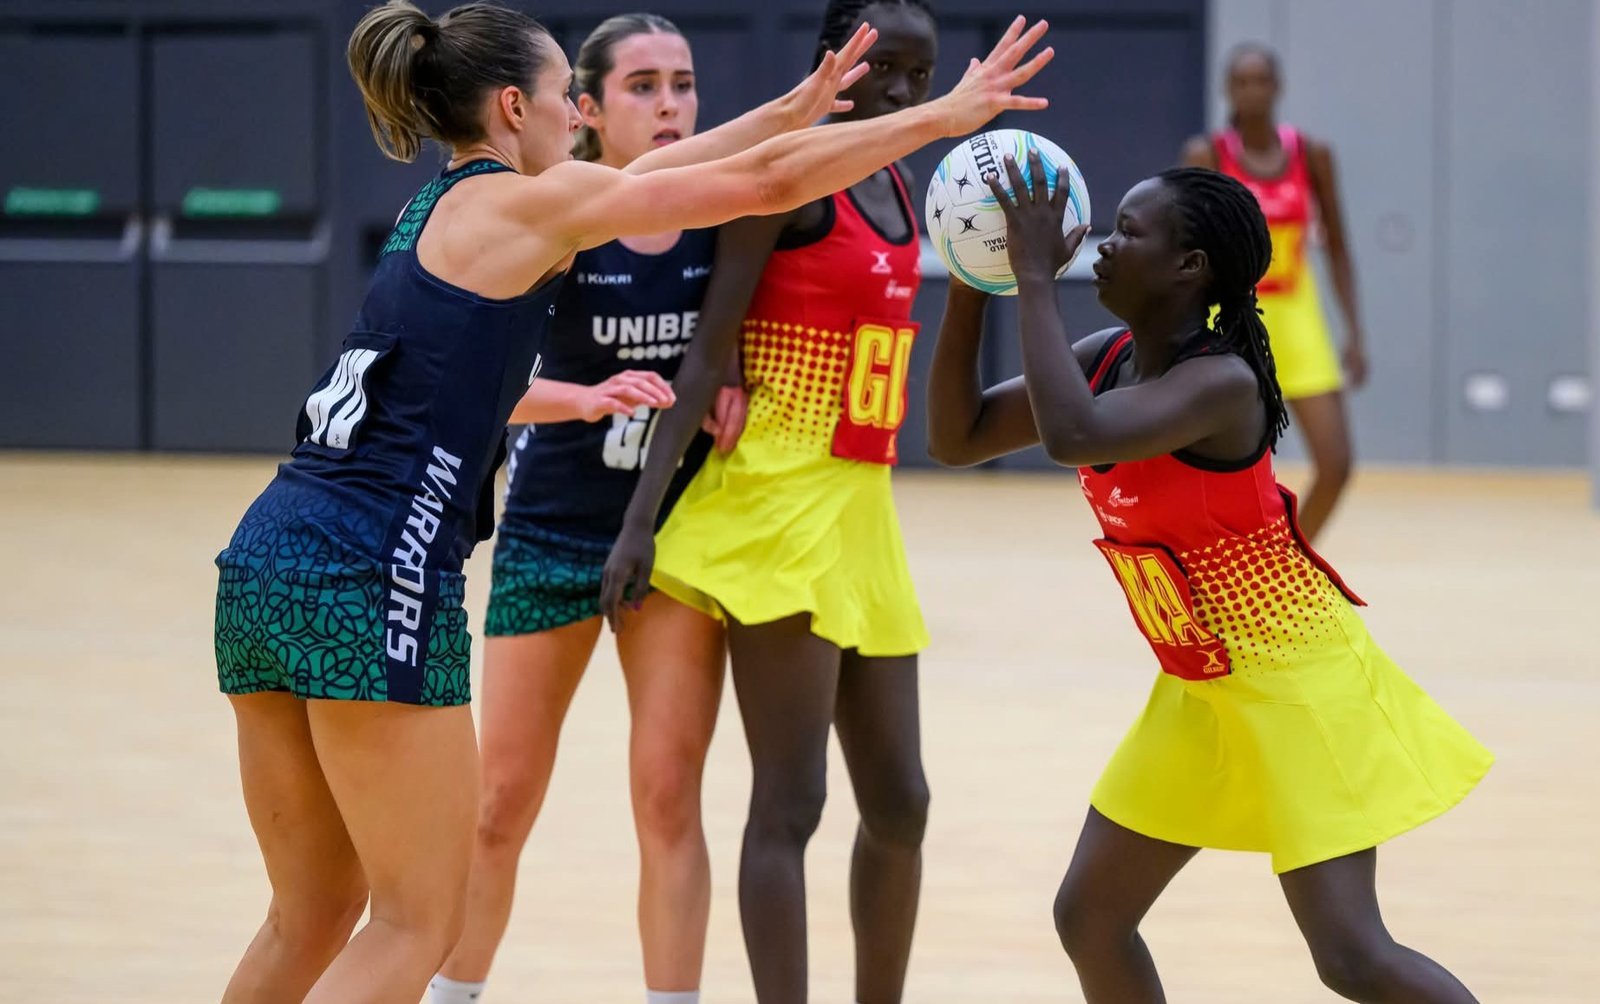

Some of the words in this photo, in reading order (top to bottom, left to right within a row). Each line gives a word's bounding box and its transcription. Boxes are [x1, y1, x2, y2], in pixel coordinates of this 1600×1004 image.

[982, 236, 1006, 247] TBALL
[592, 310, 699, 346] UNIBE
[386, 446, 463, 667] WARRORS
[1101, 546, 1217, 646] WA
